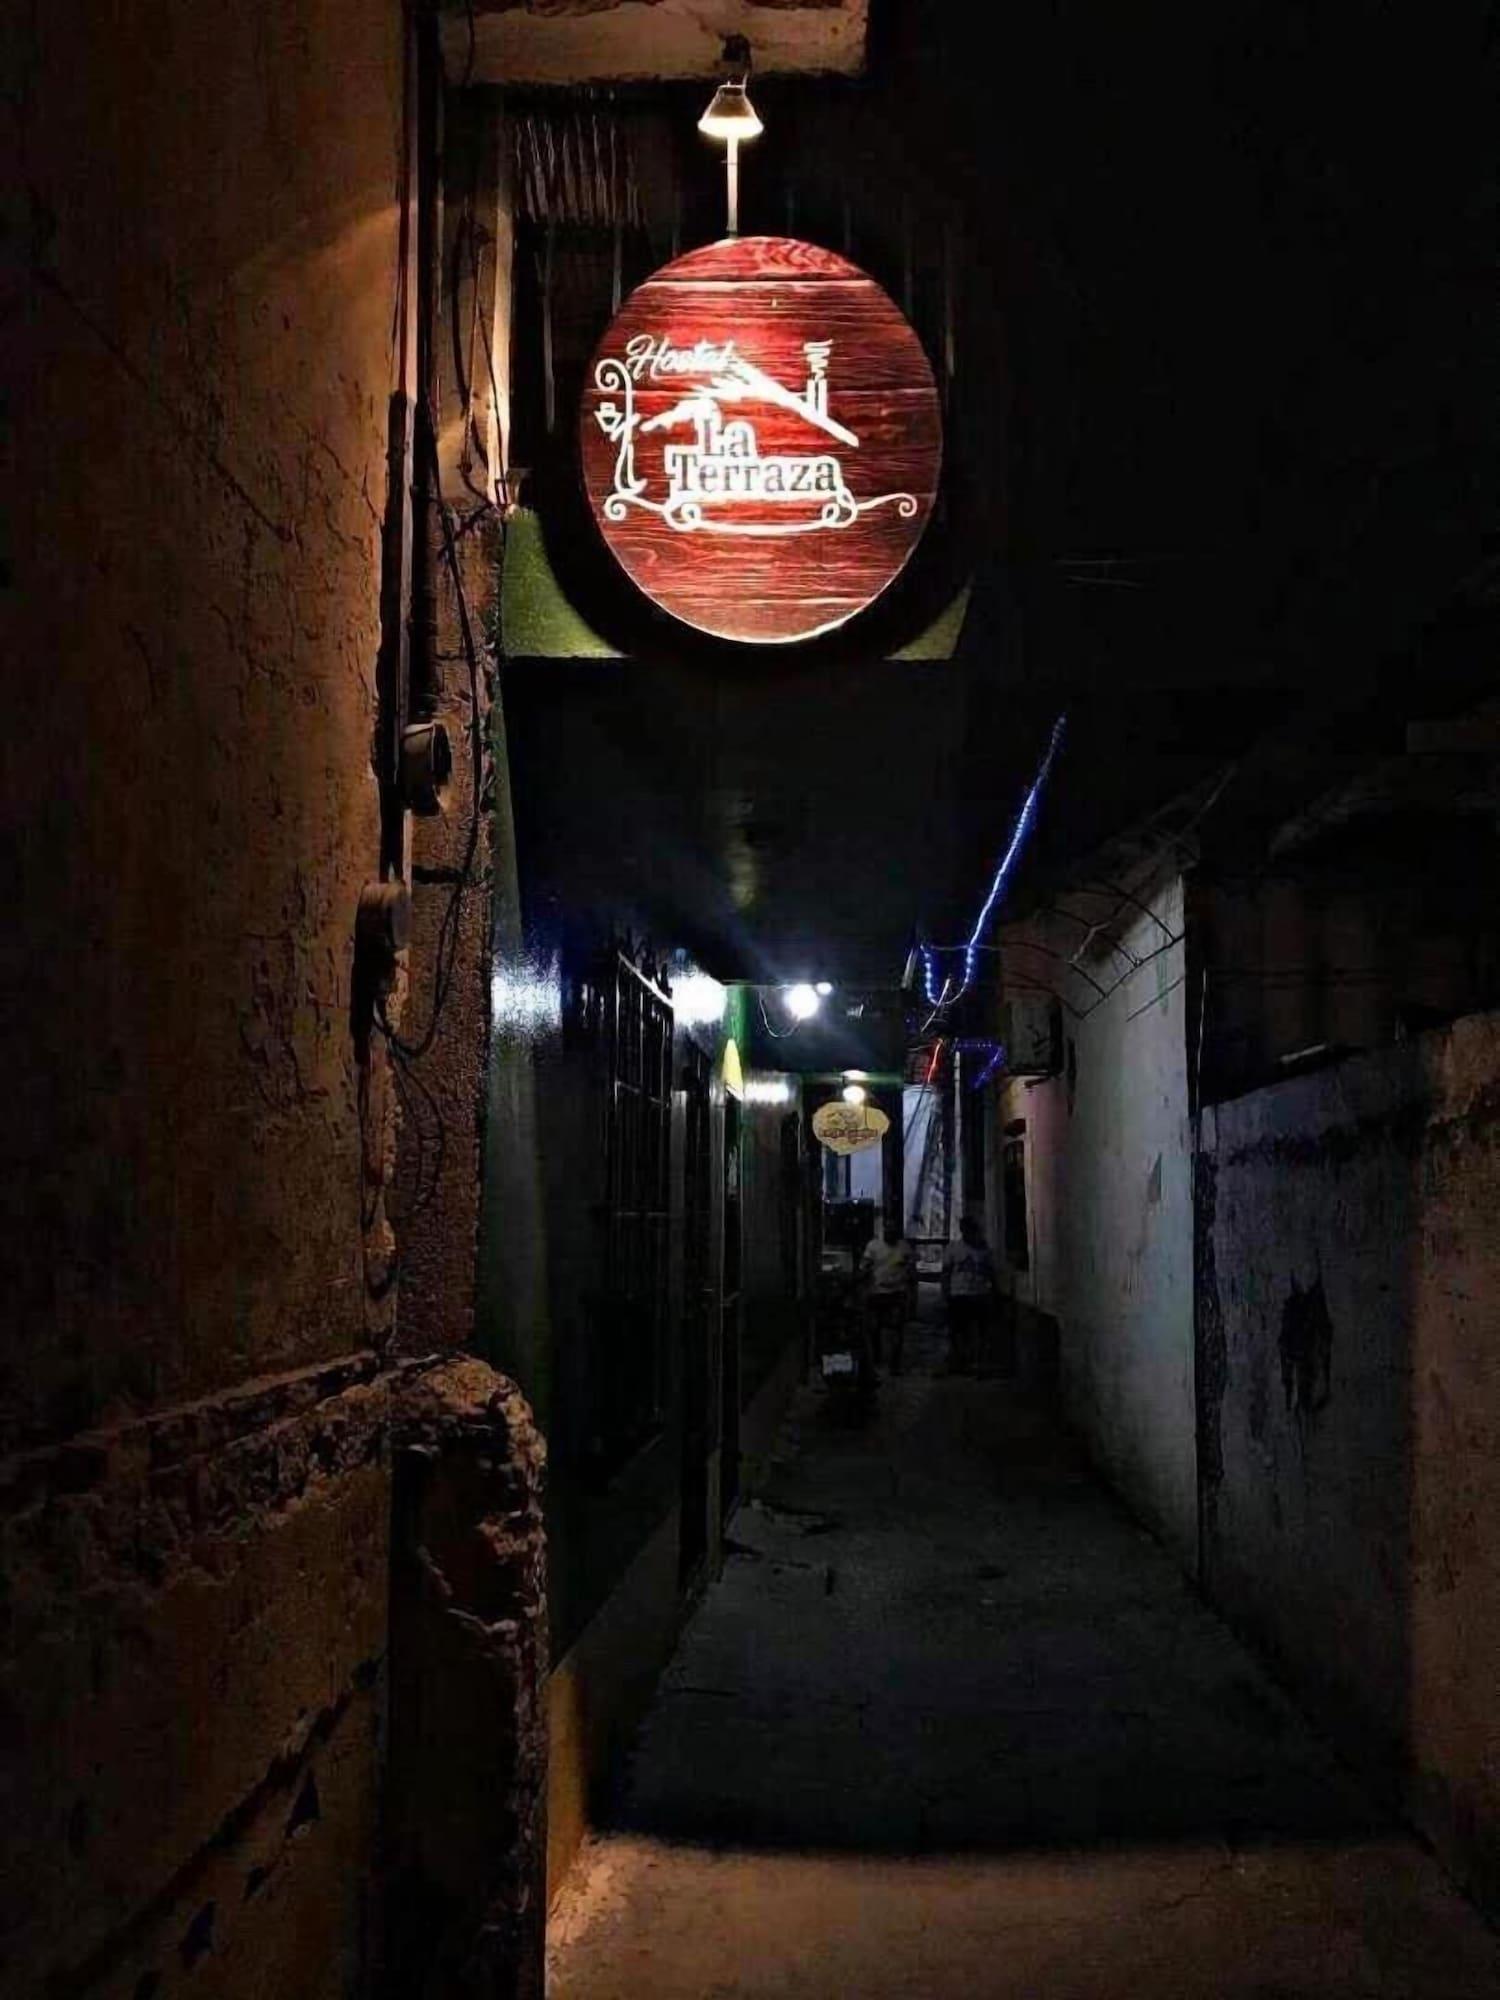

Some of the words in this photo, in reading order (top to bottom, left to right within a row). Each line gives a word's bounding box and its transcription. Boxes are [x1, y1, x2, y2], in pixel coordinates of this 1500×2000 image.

[626, 334, 735, 380] Hostel
[701, 417, 751, 457] La
[671, 452, 838, 493] Terraza
